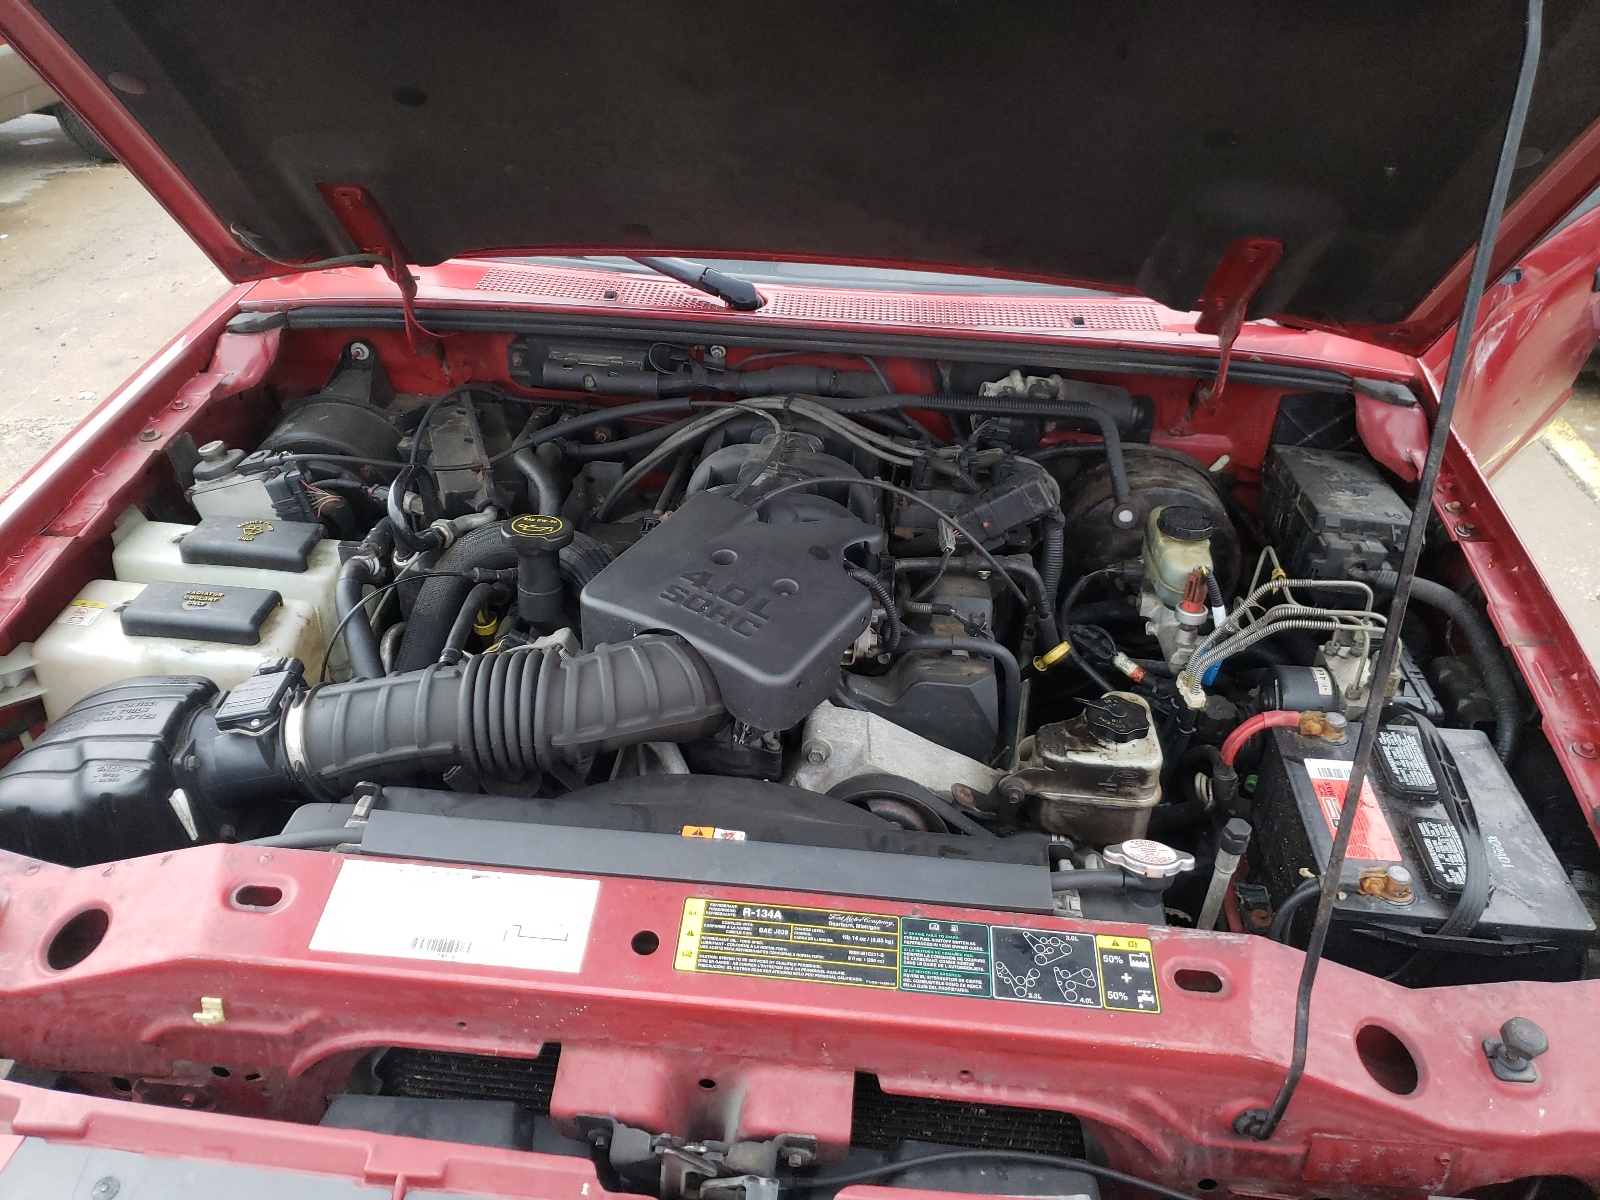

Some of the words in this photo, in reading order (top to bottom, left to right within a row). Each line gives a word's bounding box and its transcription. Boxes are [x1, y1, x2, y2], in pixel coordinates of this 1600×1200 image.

[680, 571, 771, 621] 4.0L
[659, 584, 762, 637] SOHC
[742, 908, 783, 919] R-134A
[828, 913, 844, 921] Ford
[1103, 955, 1123, 964] 50%
[1107, 991, 1128, 1001] 50%
